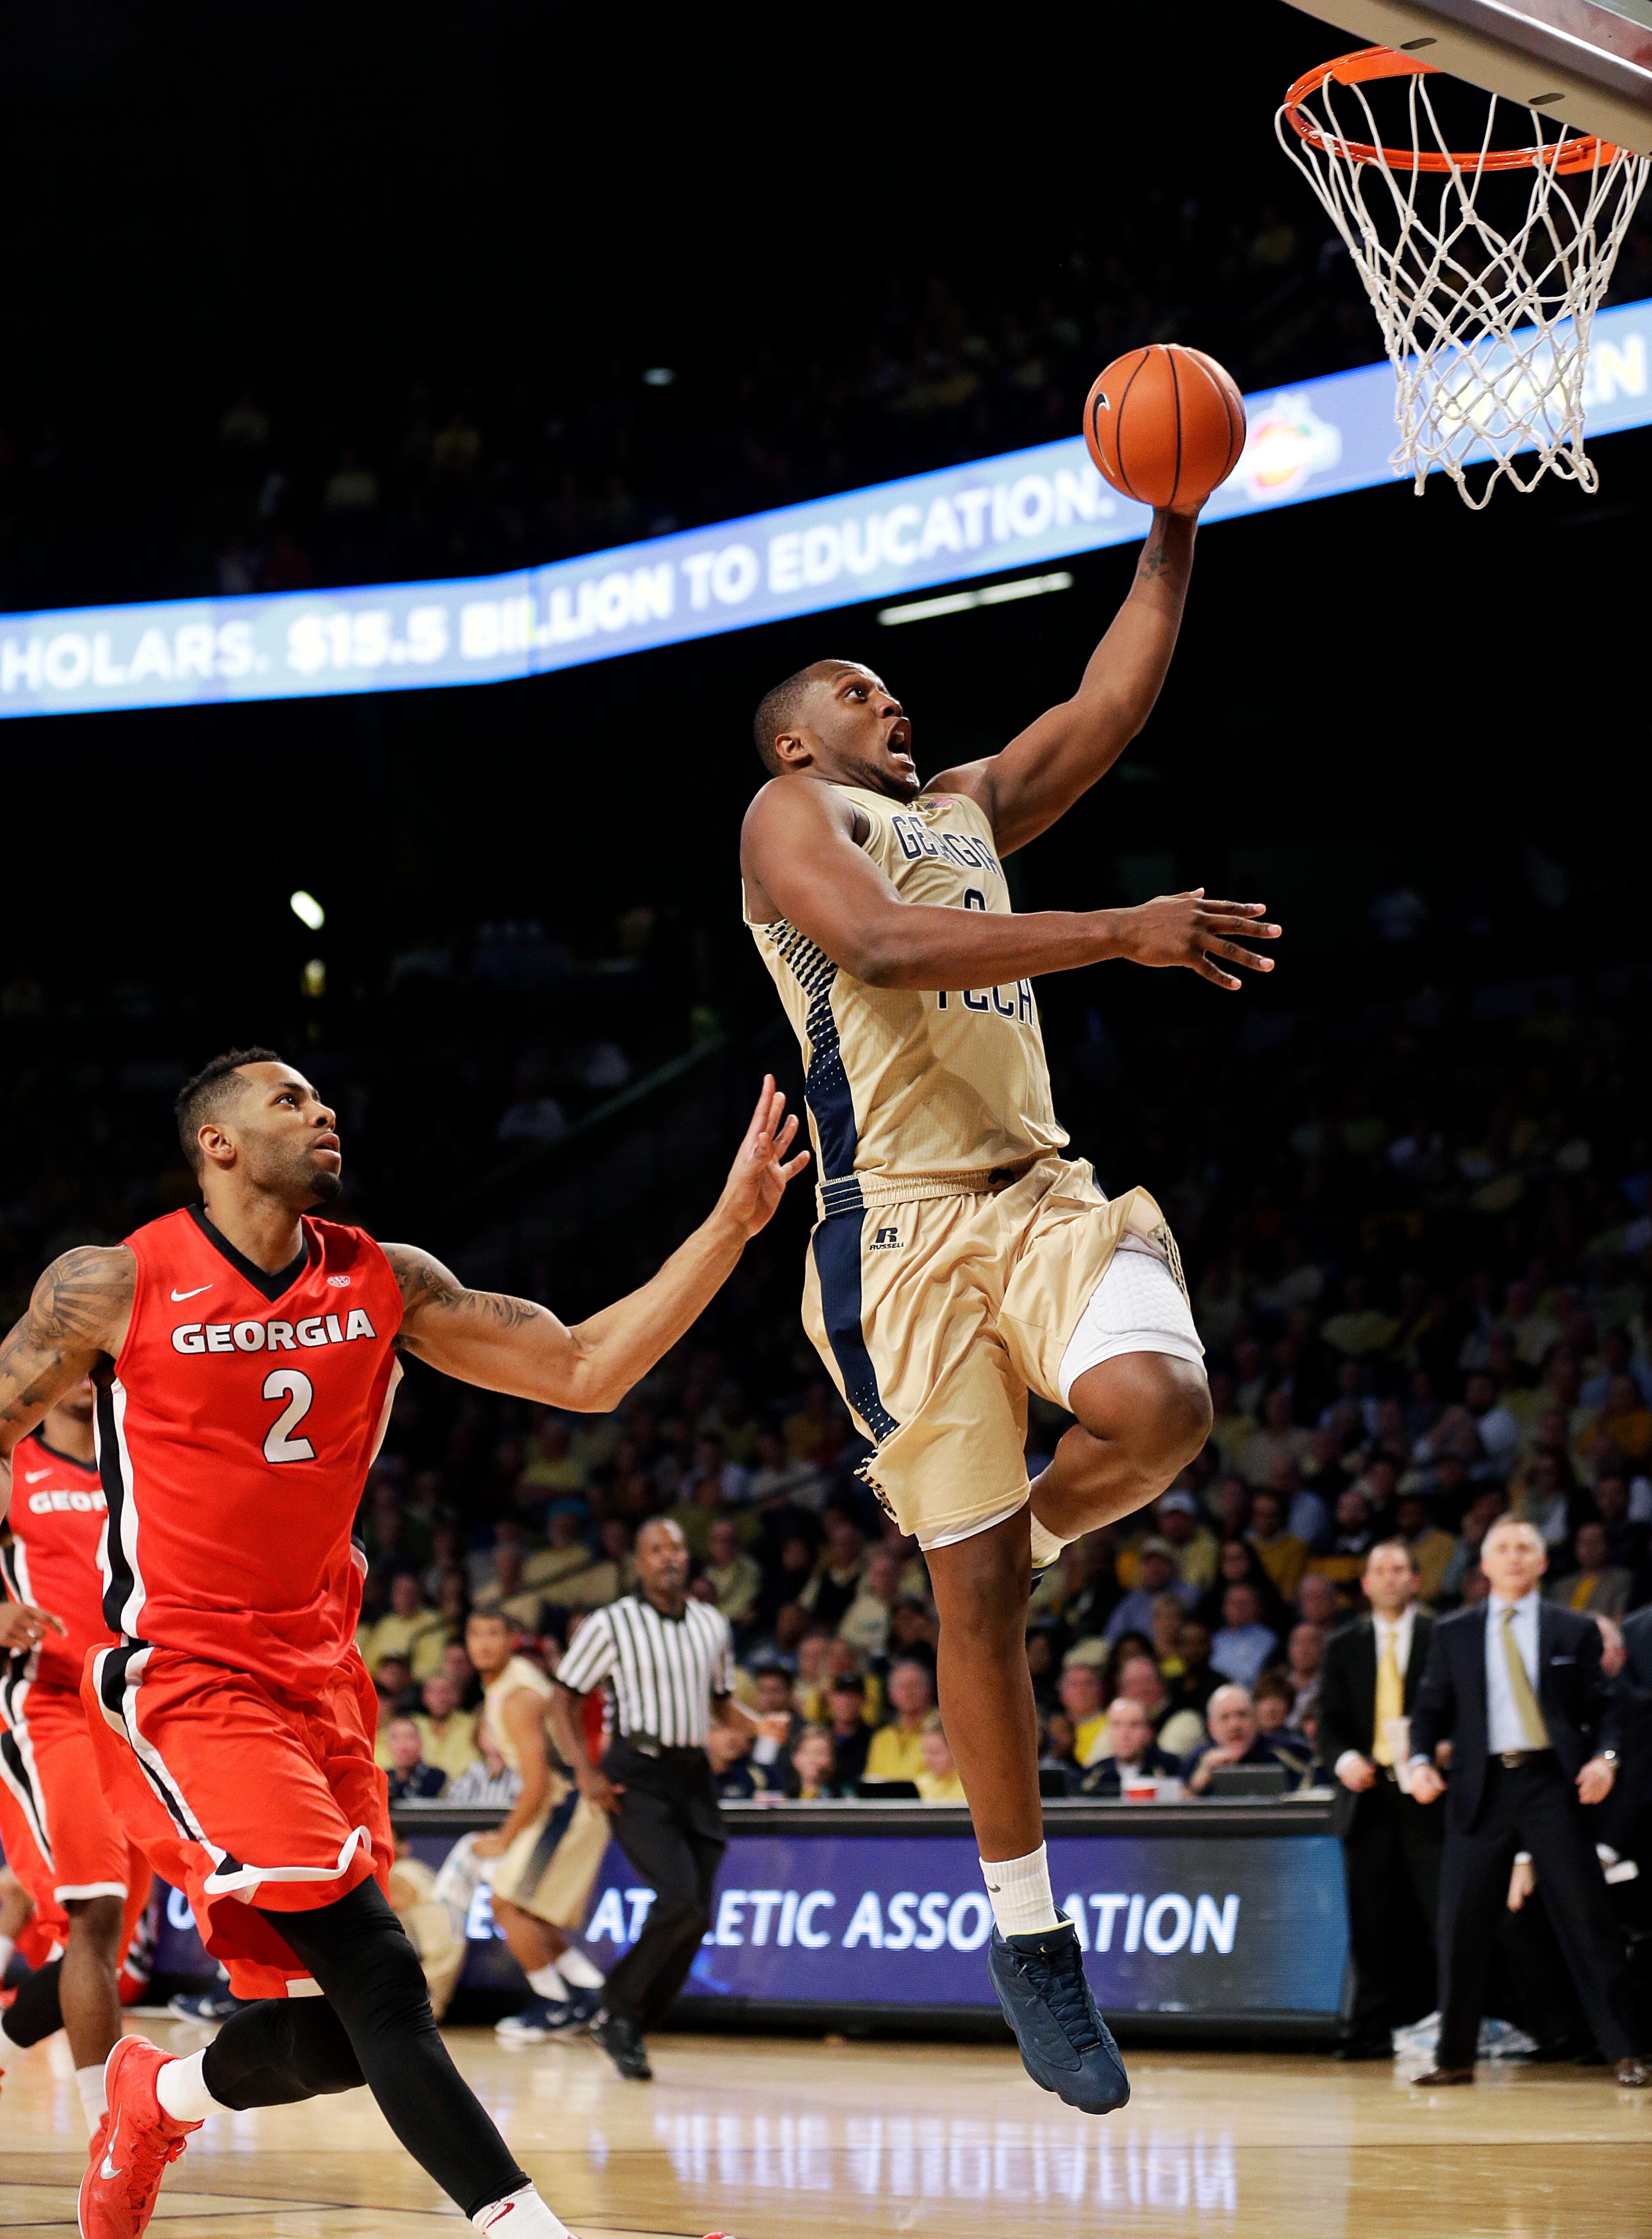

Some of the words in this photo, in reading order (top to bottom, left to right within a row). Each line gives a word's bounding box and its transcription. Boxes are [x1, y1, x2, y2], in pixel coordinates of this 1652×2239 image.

[286, 605, 450, 676] $15.5
[459, 561, 675, 660] BILLION
[681, 543, 760, 611] TO
[767, 463, 1118, 595] EDUCATION.
[891, 814, 1006, 883] GERGIA
[869, 1242, 904, 1250] RUSSELL
[171, 1308, 377, 1354] GEORGIA
[262, 1368, 317, 1463] 2
[585, 1887, 836, 1949] ATETIC
[842, 1890, 1241, 1955] ASSOATION
